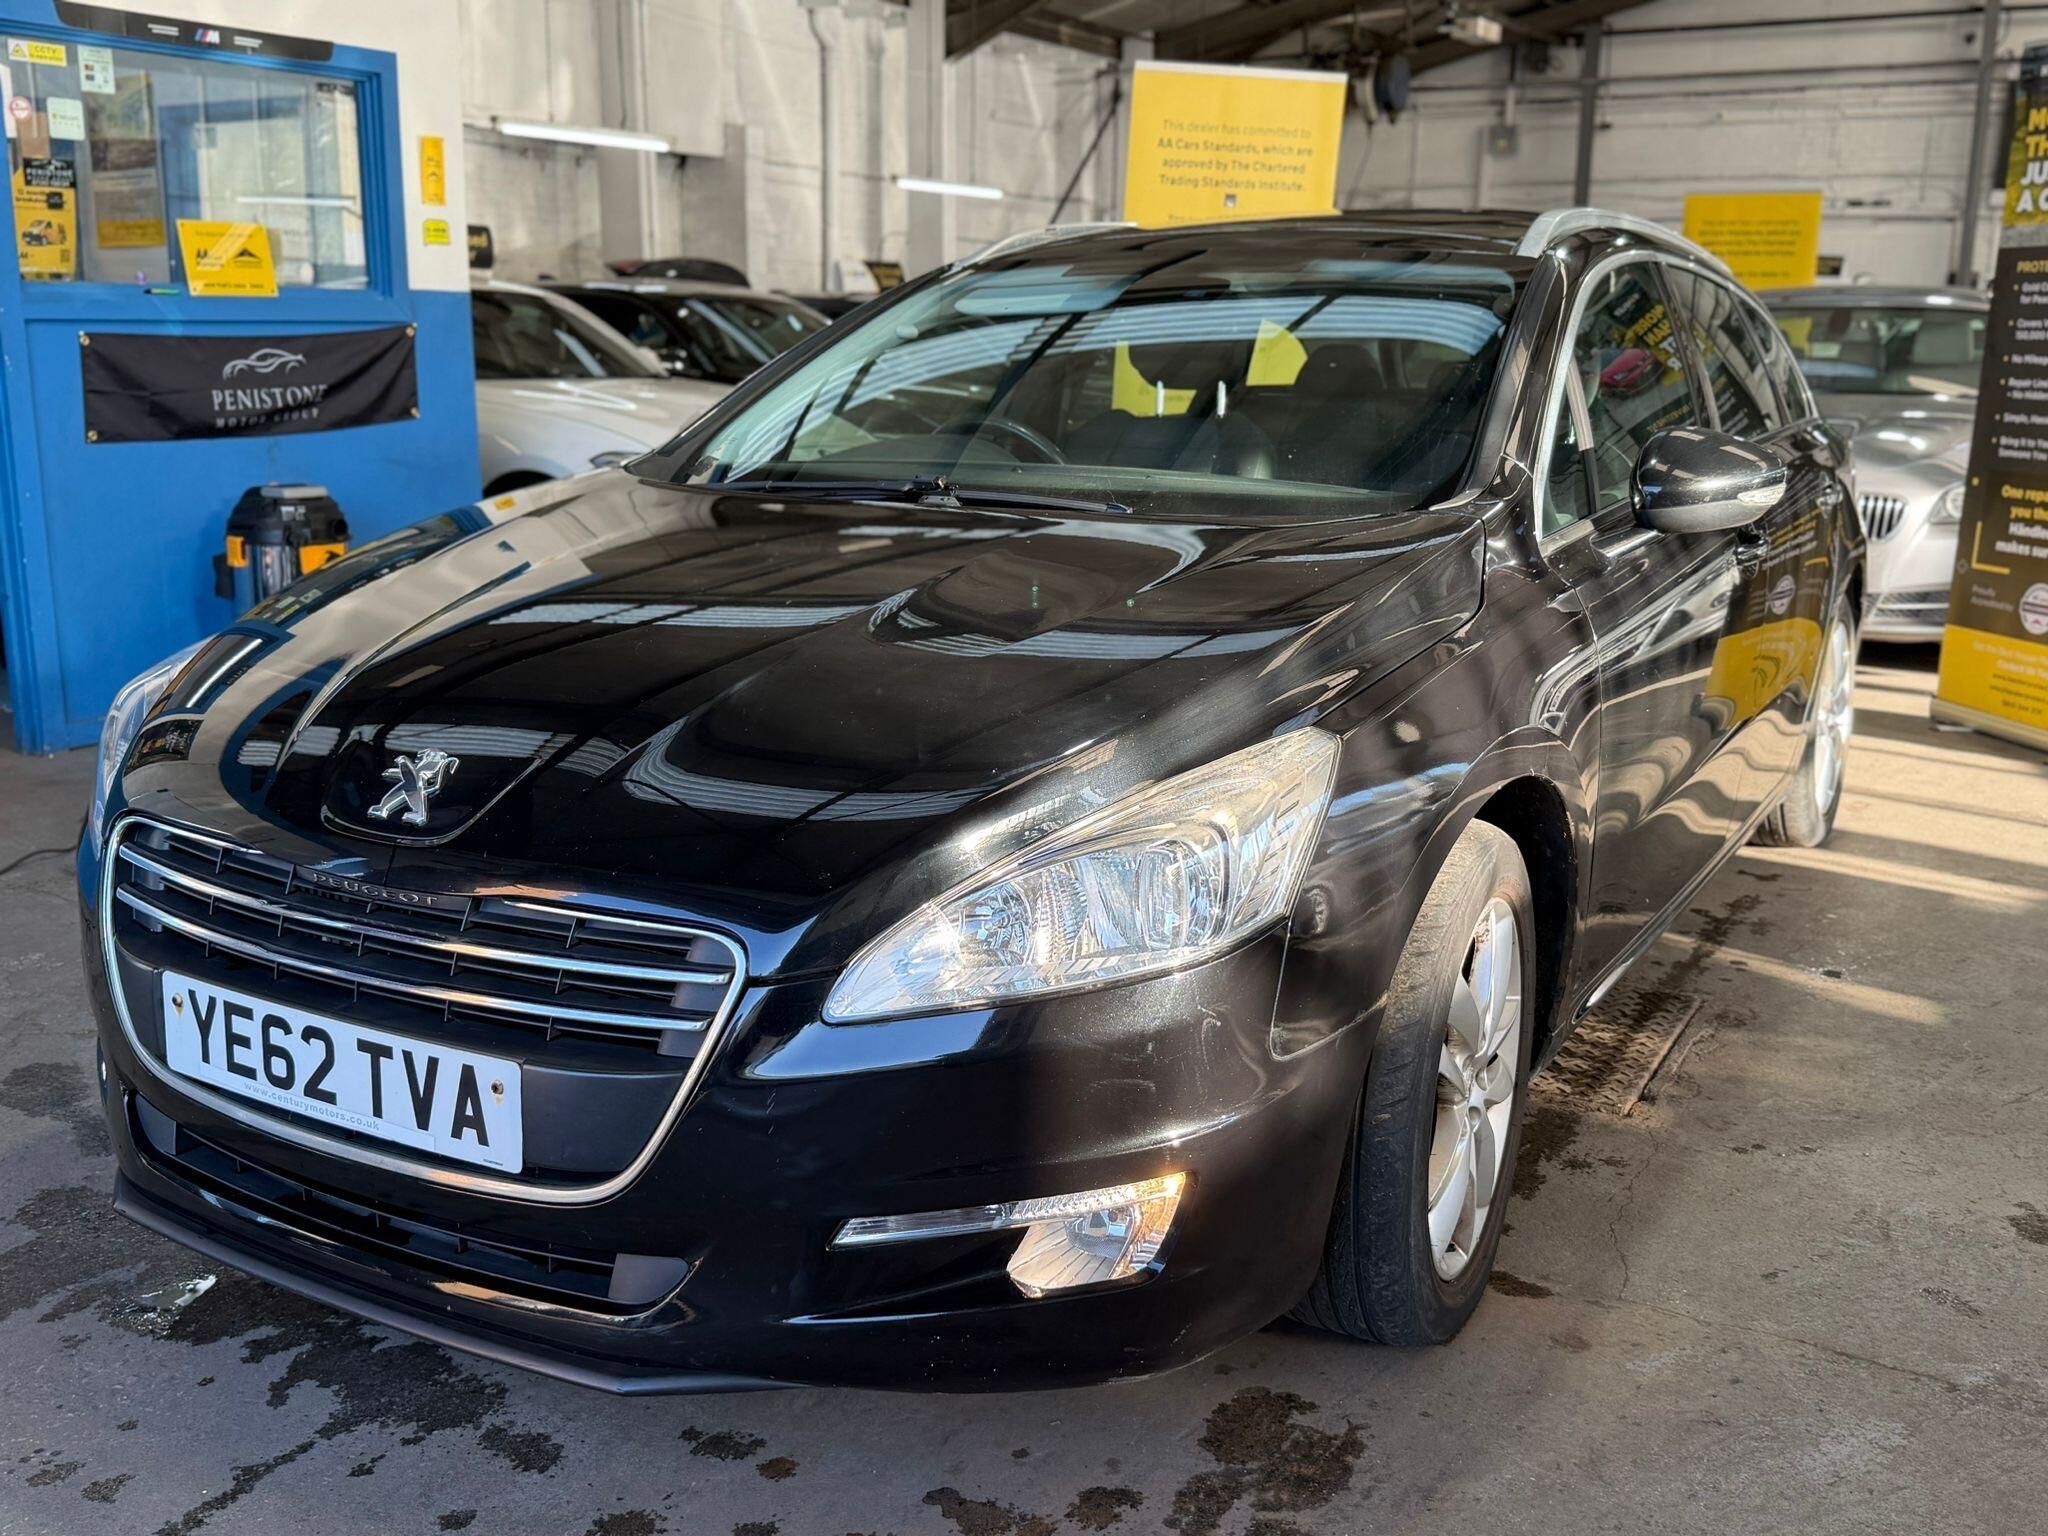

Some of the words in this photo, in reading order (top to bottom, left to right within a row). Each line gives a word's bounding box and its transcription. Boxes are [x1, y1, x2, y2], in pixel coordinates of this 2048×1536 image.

[1163, 119, 1184, 130] This
[1186, 121, 1219, 132] dealer
[1222, 124, 1240, 134] has
[1243, 126, 1298, 138] committed
[1300, 129, 1312, 139] to
[1158, 138, 1173, 148] AA
[1175, 139, 1200, 150] Cars
[1203, 140, 1260, 154] Standards,
[1263, 144, 1294, 154] which
[1297, 148, 1313, 156] are
[1162, 158, 1214, 170] approved
[1216, 160, 1228, 172] by
[1231, 160, 1250, 171] The
[1252, 162, 1306, 174] Chartered
[1159, 174, 1200, 189] Trading
[1202, 176, 1256, 189] Standards
[1259, 179, 1306, 192] Institute.
[2002, 484, 2024, 500] One
[2010, 505, 2032, 519] you
[313, 873, 438, 906] PEUGEOT
[188, 988, 338, 1106] YE62
[356, 1036, 490, 1148] TVA
[243, 1081, 381, 1132] www.centurymotors.co.uk
